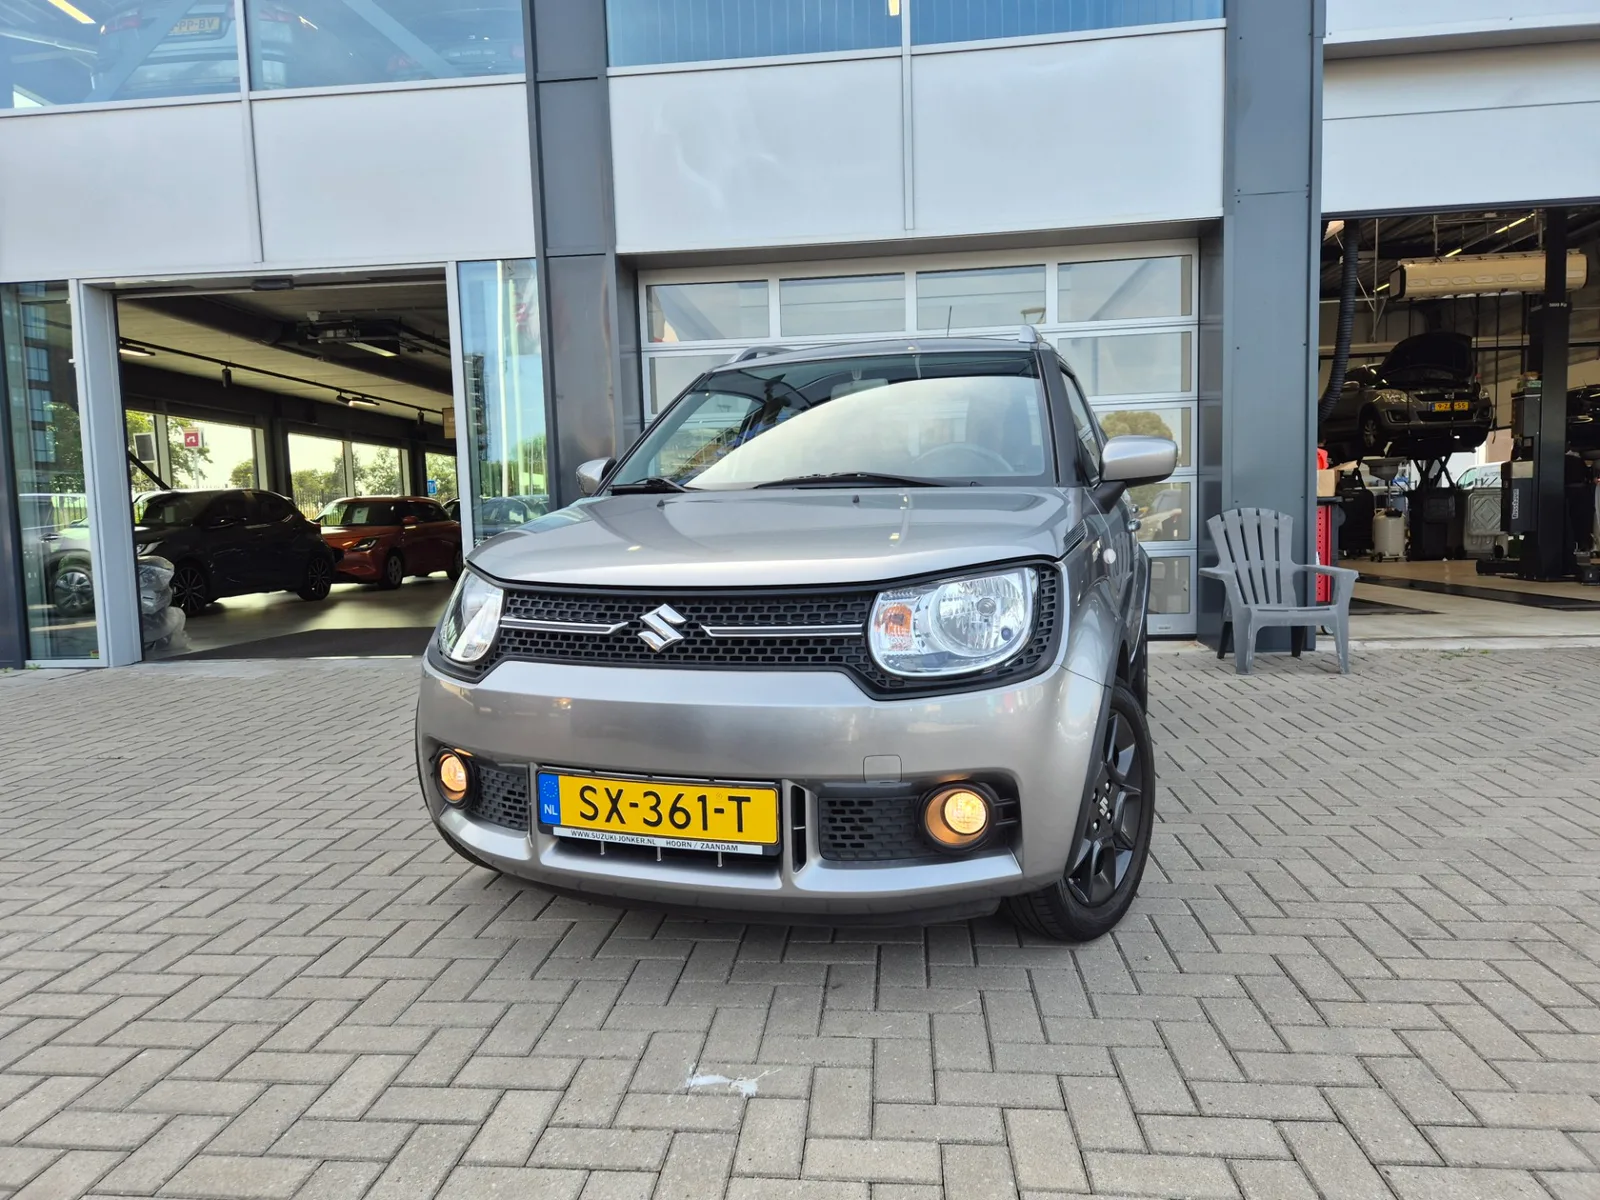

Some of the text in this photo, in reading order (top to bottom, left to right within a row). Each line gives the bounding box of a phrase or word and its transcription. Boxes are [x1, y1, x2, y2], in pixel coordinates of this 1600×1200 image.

[544, 804, 558, 816] NL
[579, 785, 751, 833] SX-361-T
[571, 830, 656, 845] WWW.SUZUKI-JONKER.NL
[665, 839, 692, 849] HOORN
[700, 842, 739, 852] ZAANDAM
